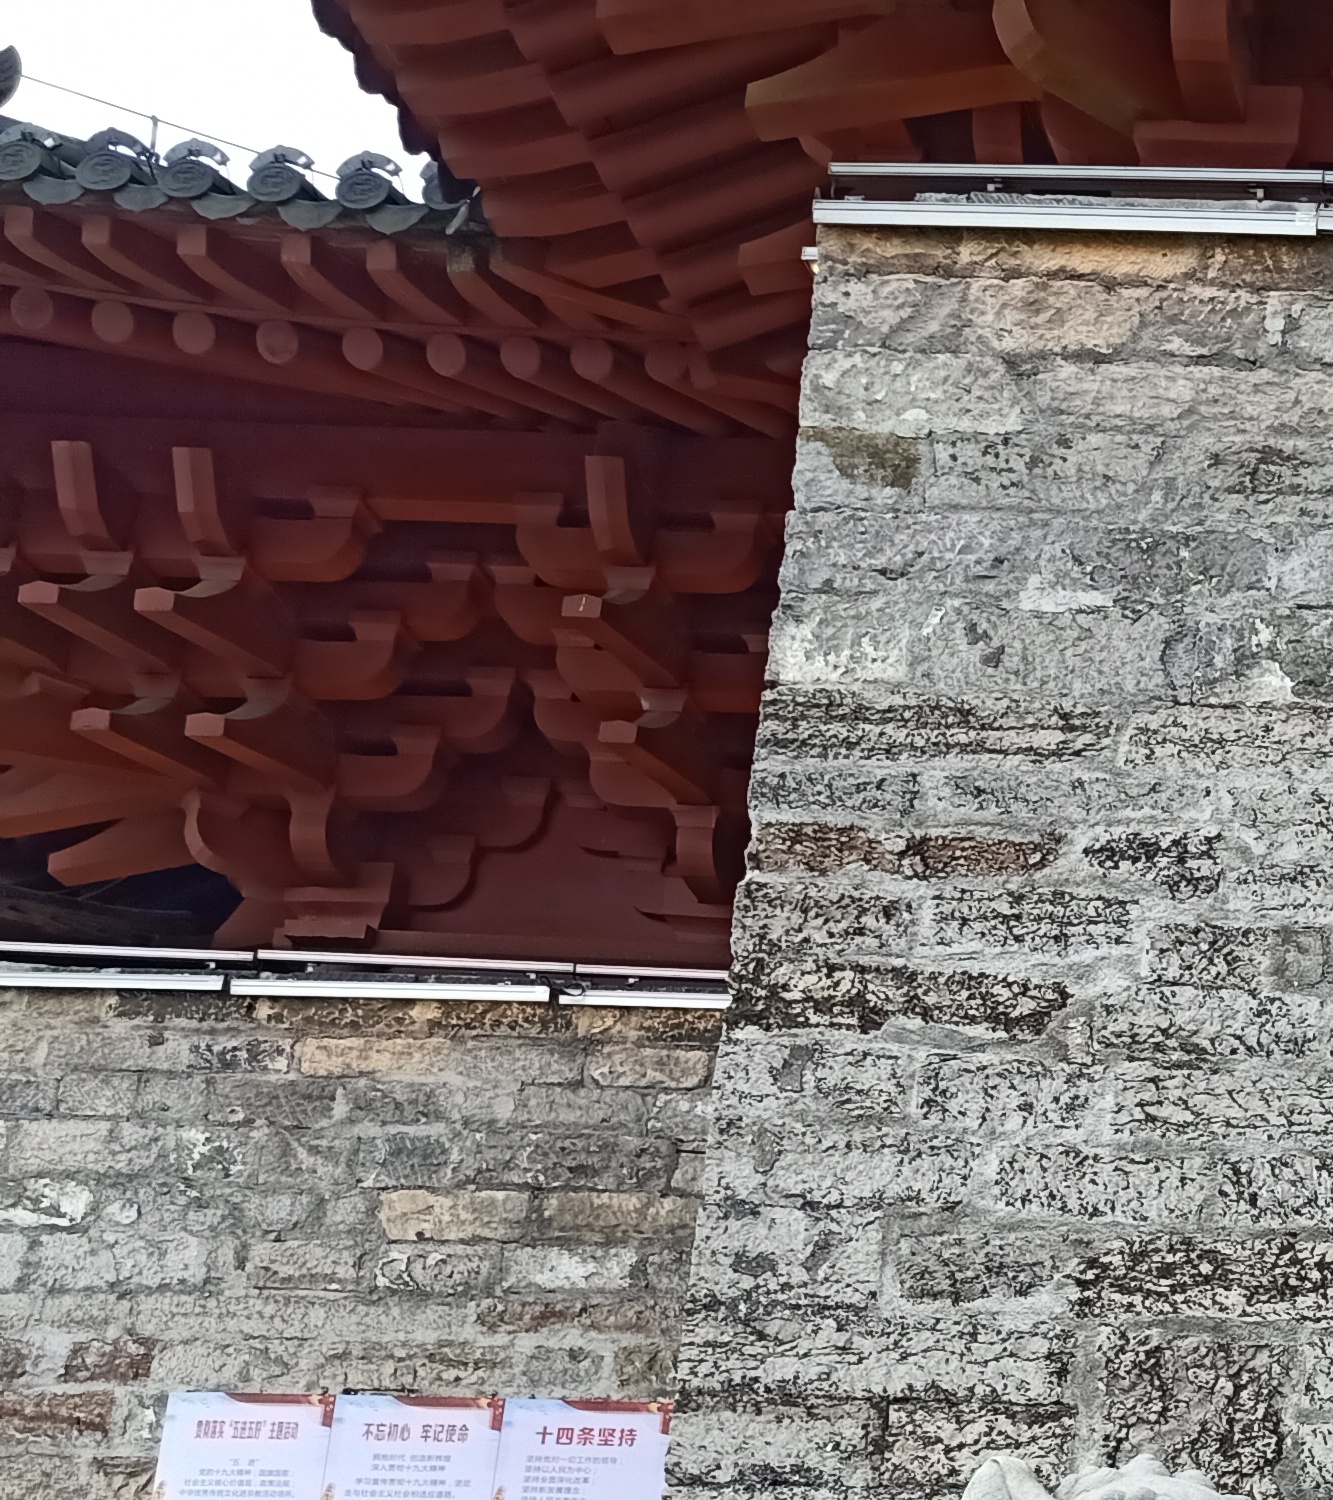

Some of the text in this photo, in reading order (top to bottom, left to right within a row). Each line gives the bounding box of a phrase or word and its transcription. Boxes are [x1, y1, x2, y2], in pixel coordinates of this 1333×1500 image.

[362, 1422, 469, 1443] 不忘初心 牢记使命
[535, 1426, 637, 1447] 十四条坚持
